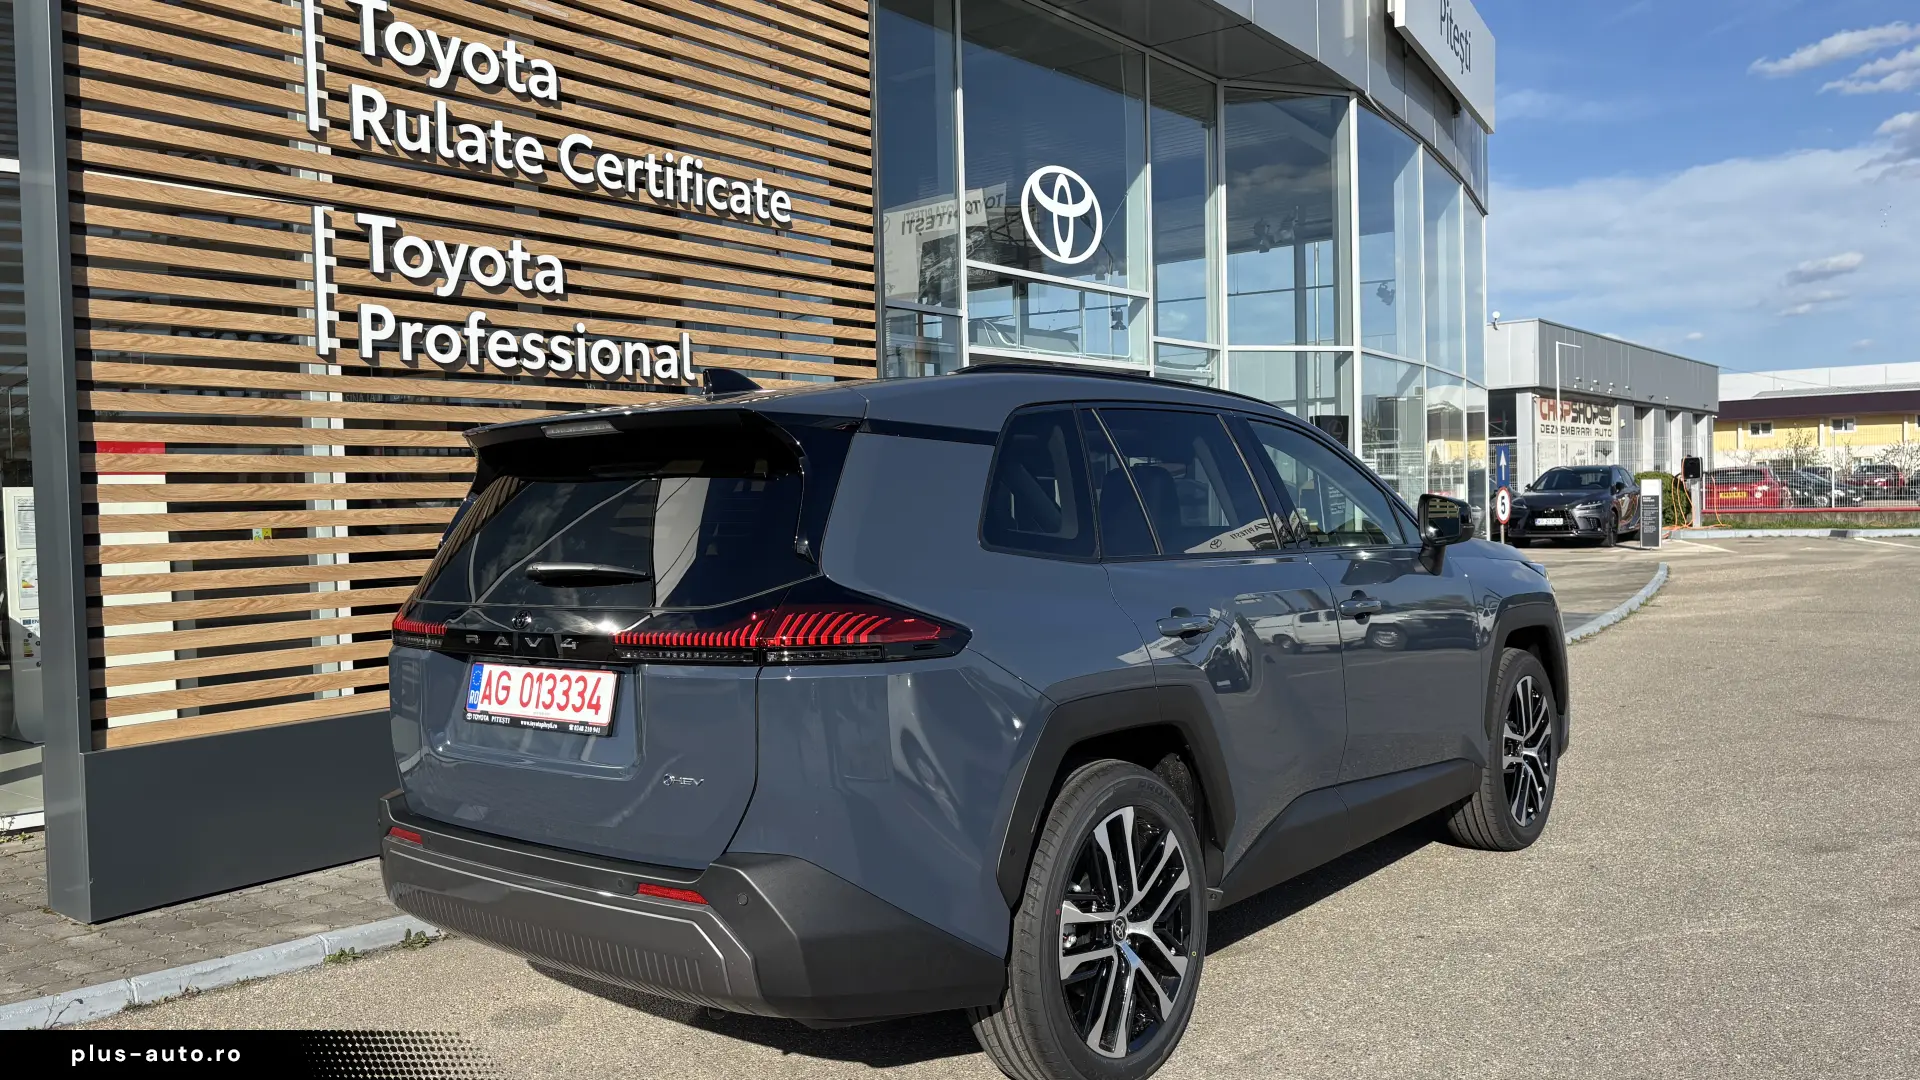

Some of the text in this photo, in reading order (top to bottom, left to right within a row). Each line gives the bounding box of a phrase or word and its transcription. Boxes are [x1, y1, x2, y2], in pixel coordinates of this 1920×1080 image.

[348, 0, 558, 101] Toyota
[350, 83, 793, 224] Rulate Certificate
[357, 212, 565, 297] Toyota
[359, 303, 697, 381] Professional
[1594, 428, 1612, 437] AUTO
[1501, 495, 1506, 514] 5
[465, 634, 577, 650] RAV4
[469, 689, 480, 704] RO
[480, 670, 602, 715] AG 013334
[472, 713, 489, 721] TOYOTA
